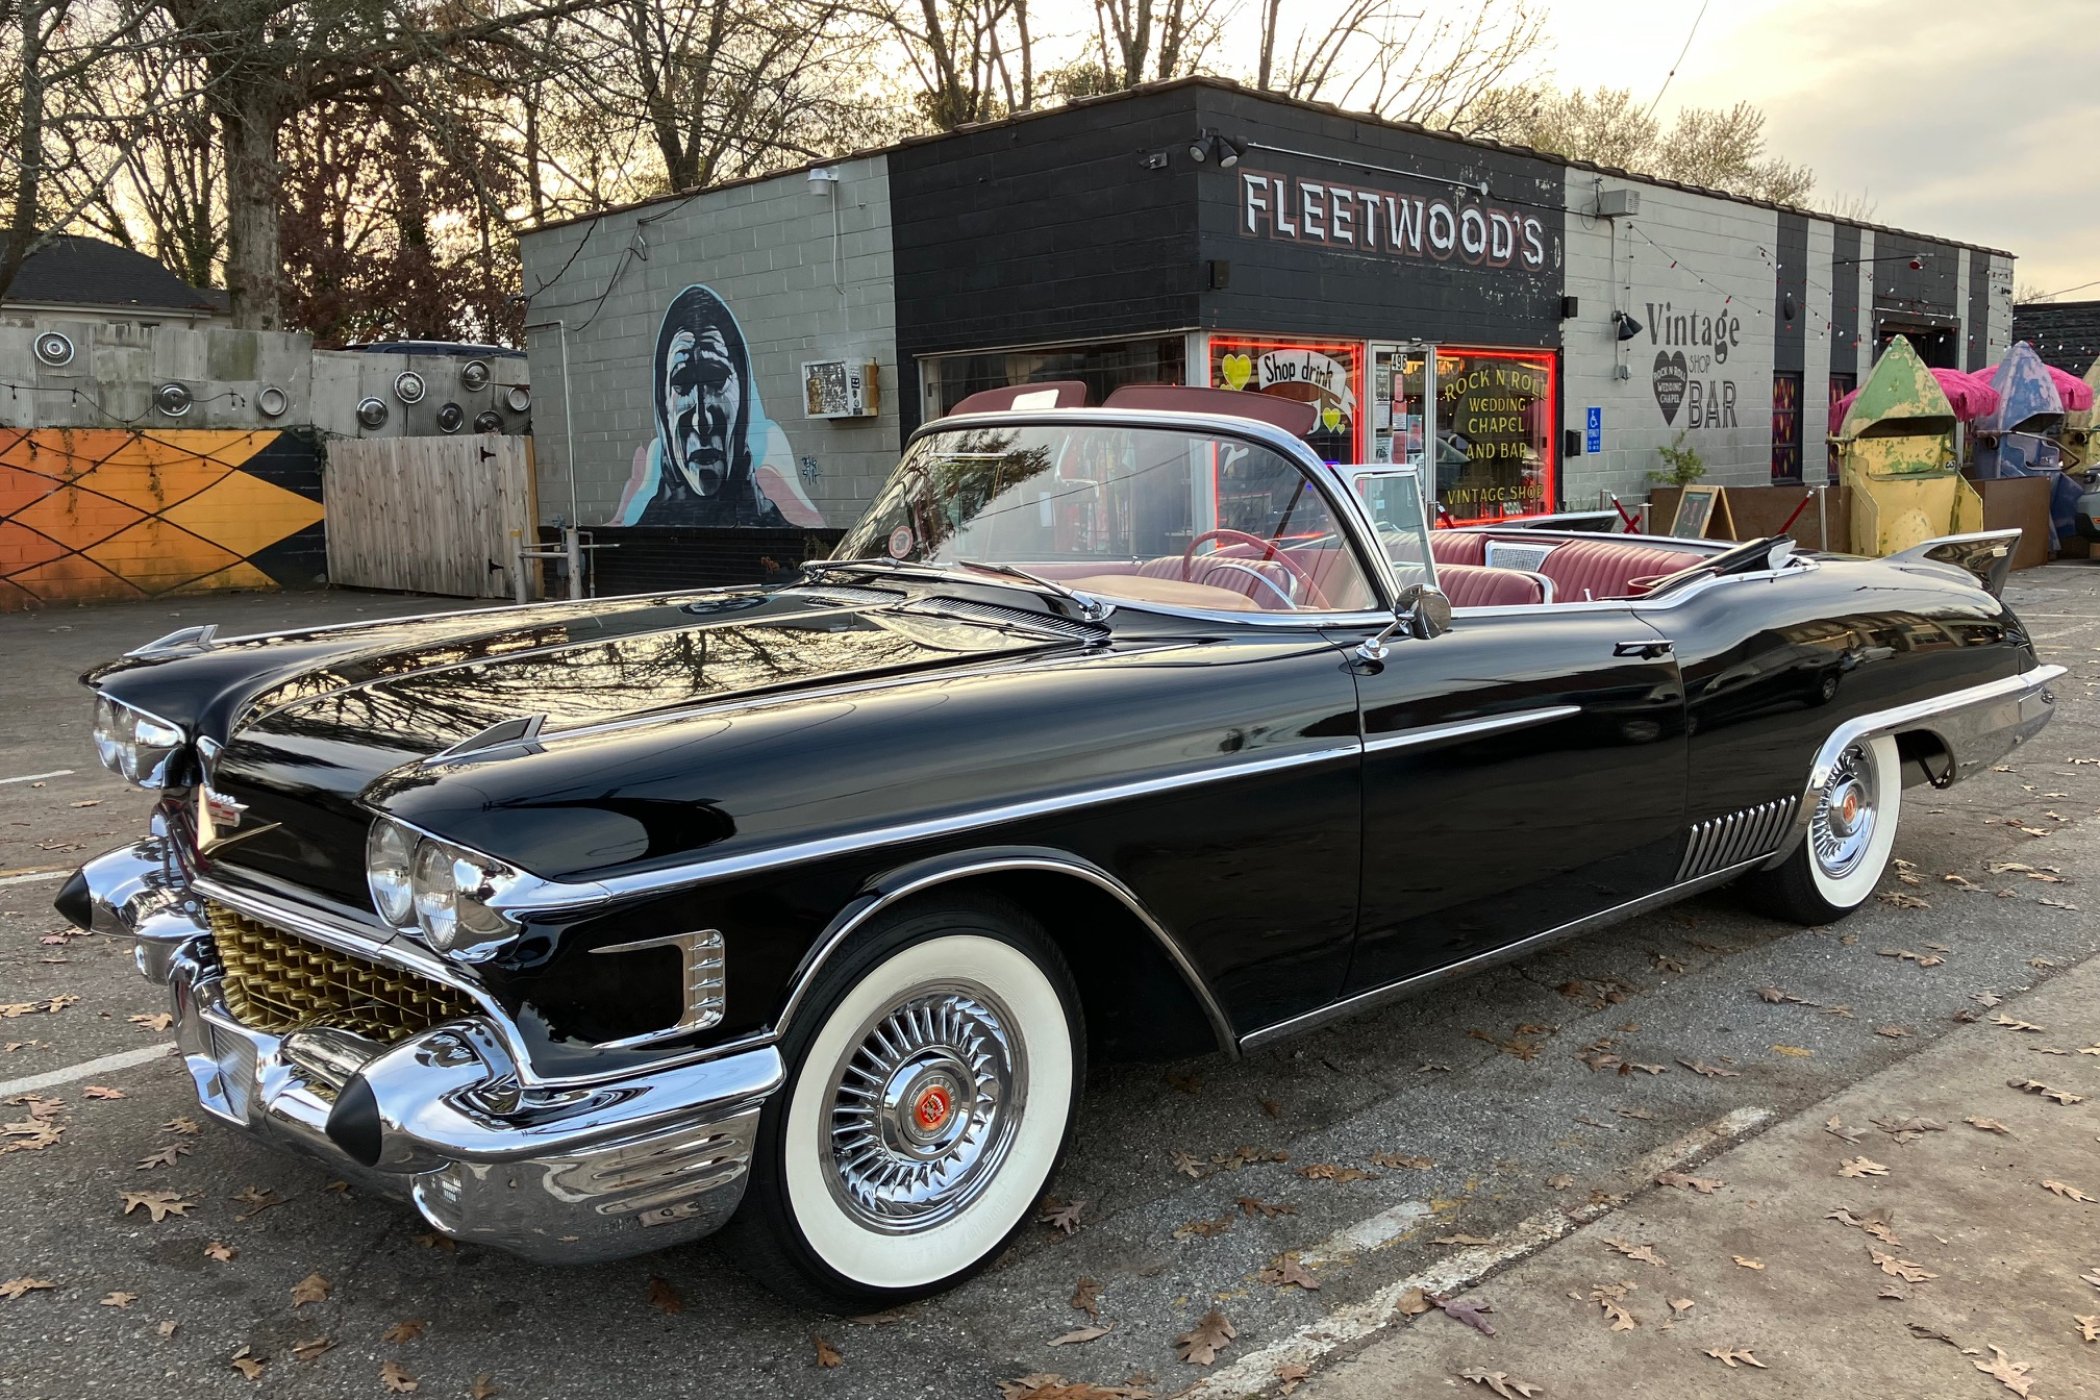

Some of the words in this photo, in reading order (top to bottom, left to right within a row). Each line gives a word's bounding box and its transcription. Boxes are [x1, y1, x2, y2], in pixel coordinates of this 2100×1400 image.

[1242, 172, 1546, 266] FLEETWOOD'S
[1645, 301, 1740, 365] Vintage
[1264, 353, 1295, 383] Shop
[1301, 352, 1333, 390] drink
[1392, 353, 1407, 370] 496
[1688, 354, 1711, 374] SHOP
[1445, 369, 1490, 402] ROCK
[1496, 369, 1505, 386] N
[1511, 371, 1548, 400] ROLL
[1469, 397, 1526, 412] WEDDING
[1688, 380, 1738, 429] BAR
[1468, 417, 1525, 434] CHAPEL
[1466, 443, 1495, 459] AND
[1500, 442, 1527, 458] BAR
[1447, 487, 1505, 505] VINTAGE
[1510, 483, 1544, 500] SHOP
